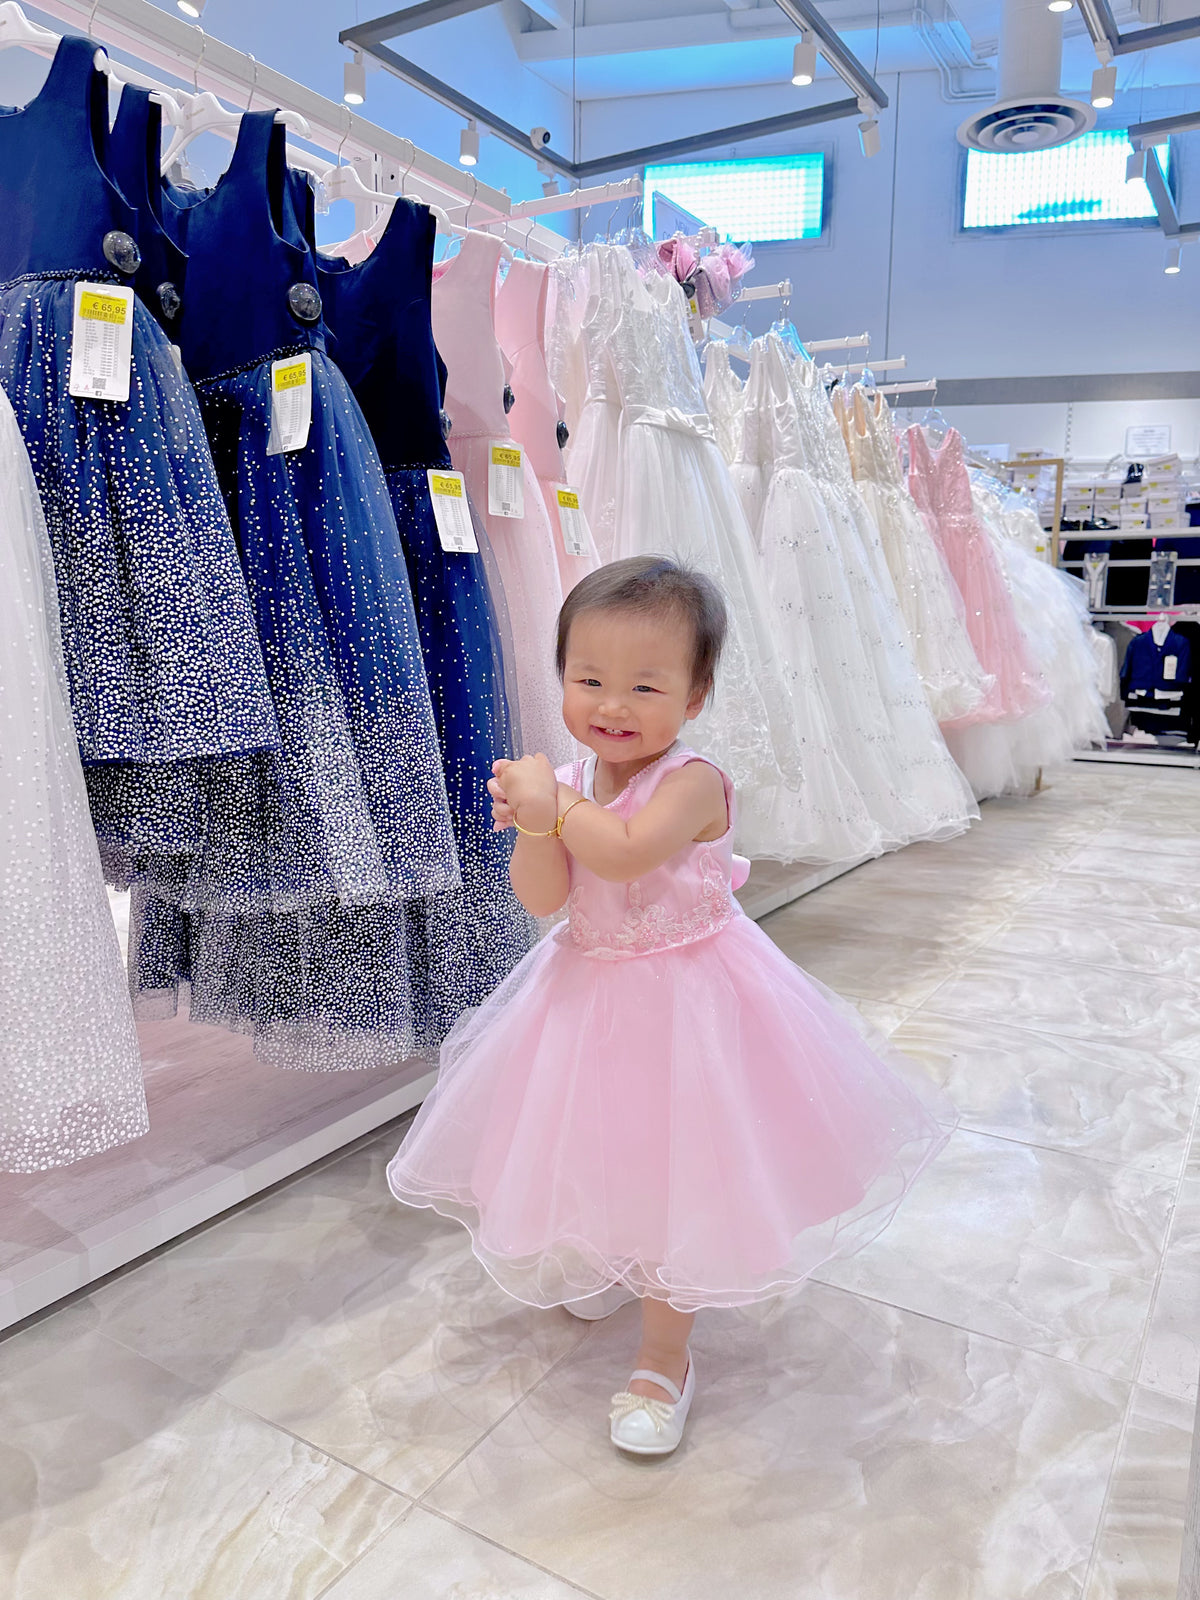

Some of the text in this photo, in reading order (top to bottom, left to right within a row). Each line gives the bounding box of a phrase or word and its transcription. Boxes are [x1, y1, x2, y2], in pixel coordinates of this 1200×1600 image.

[92, 301, 126, 315] € 65,95
[289, 369, 306, 380] 65,95
